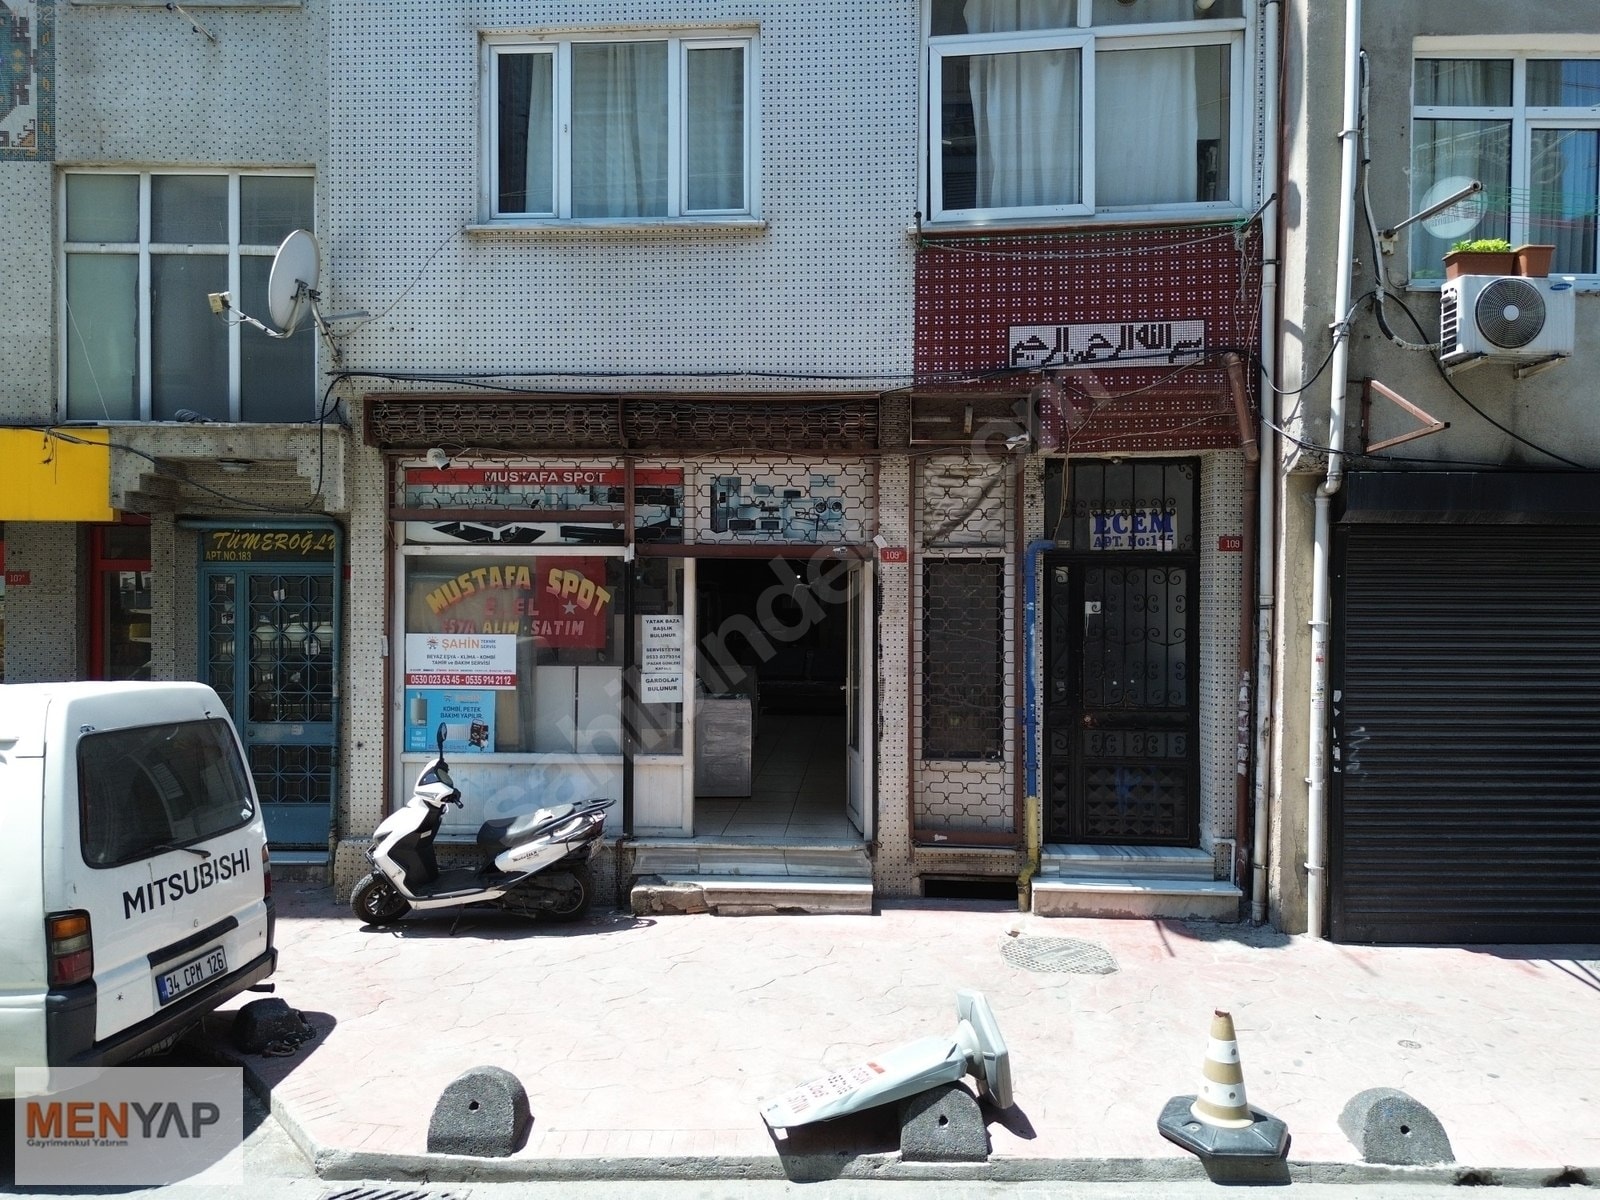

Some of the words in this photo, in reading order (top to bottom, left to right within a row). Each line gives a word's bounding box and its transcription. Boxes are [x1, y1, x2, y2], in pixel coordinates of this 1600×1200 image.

[484, 471, 558, 483] MUSTAFA
[563, 471, 606, 483] SPOT
[1093, 512, 1174, 535] ECEM
[1226, 539, 1240, 549] 109
[424, 565, 531, 616] MUSTAFA
[546, 568, 611, 617] SPOT
[482, 619, 520, 634] ALIM
[530, 620, 584, 636] SATIM
[442, 637, 480, 651] ŞAHİN
[411, 675, 427, 684] 0530
[428, 675, 440, 684] 023
[451, 675, 460, 684] 45
[465, 675, 482, 685] 0535
[495, 676, 503, 685] 21
[504, 676, 511, 685] 12
[122, 848, 250, 920] MITSUBISHI
[166, 974, 180, 995] 34
[183, 965, 203, 987] CPM
[206, 952, 224, 975] 126
